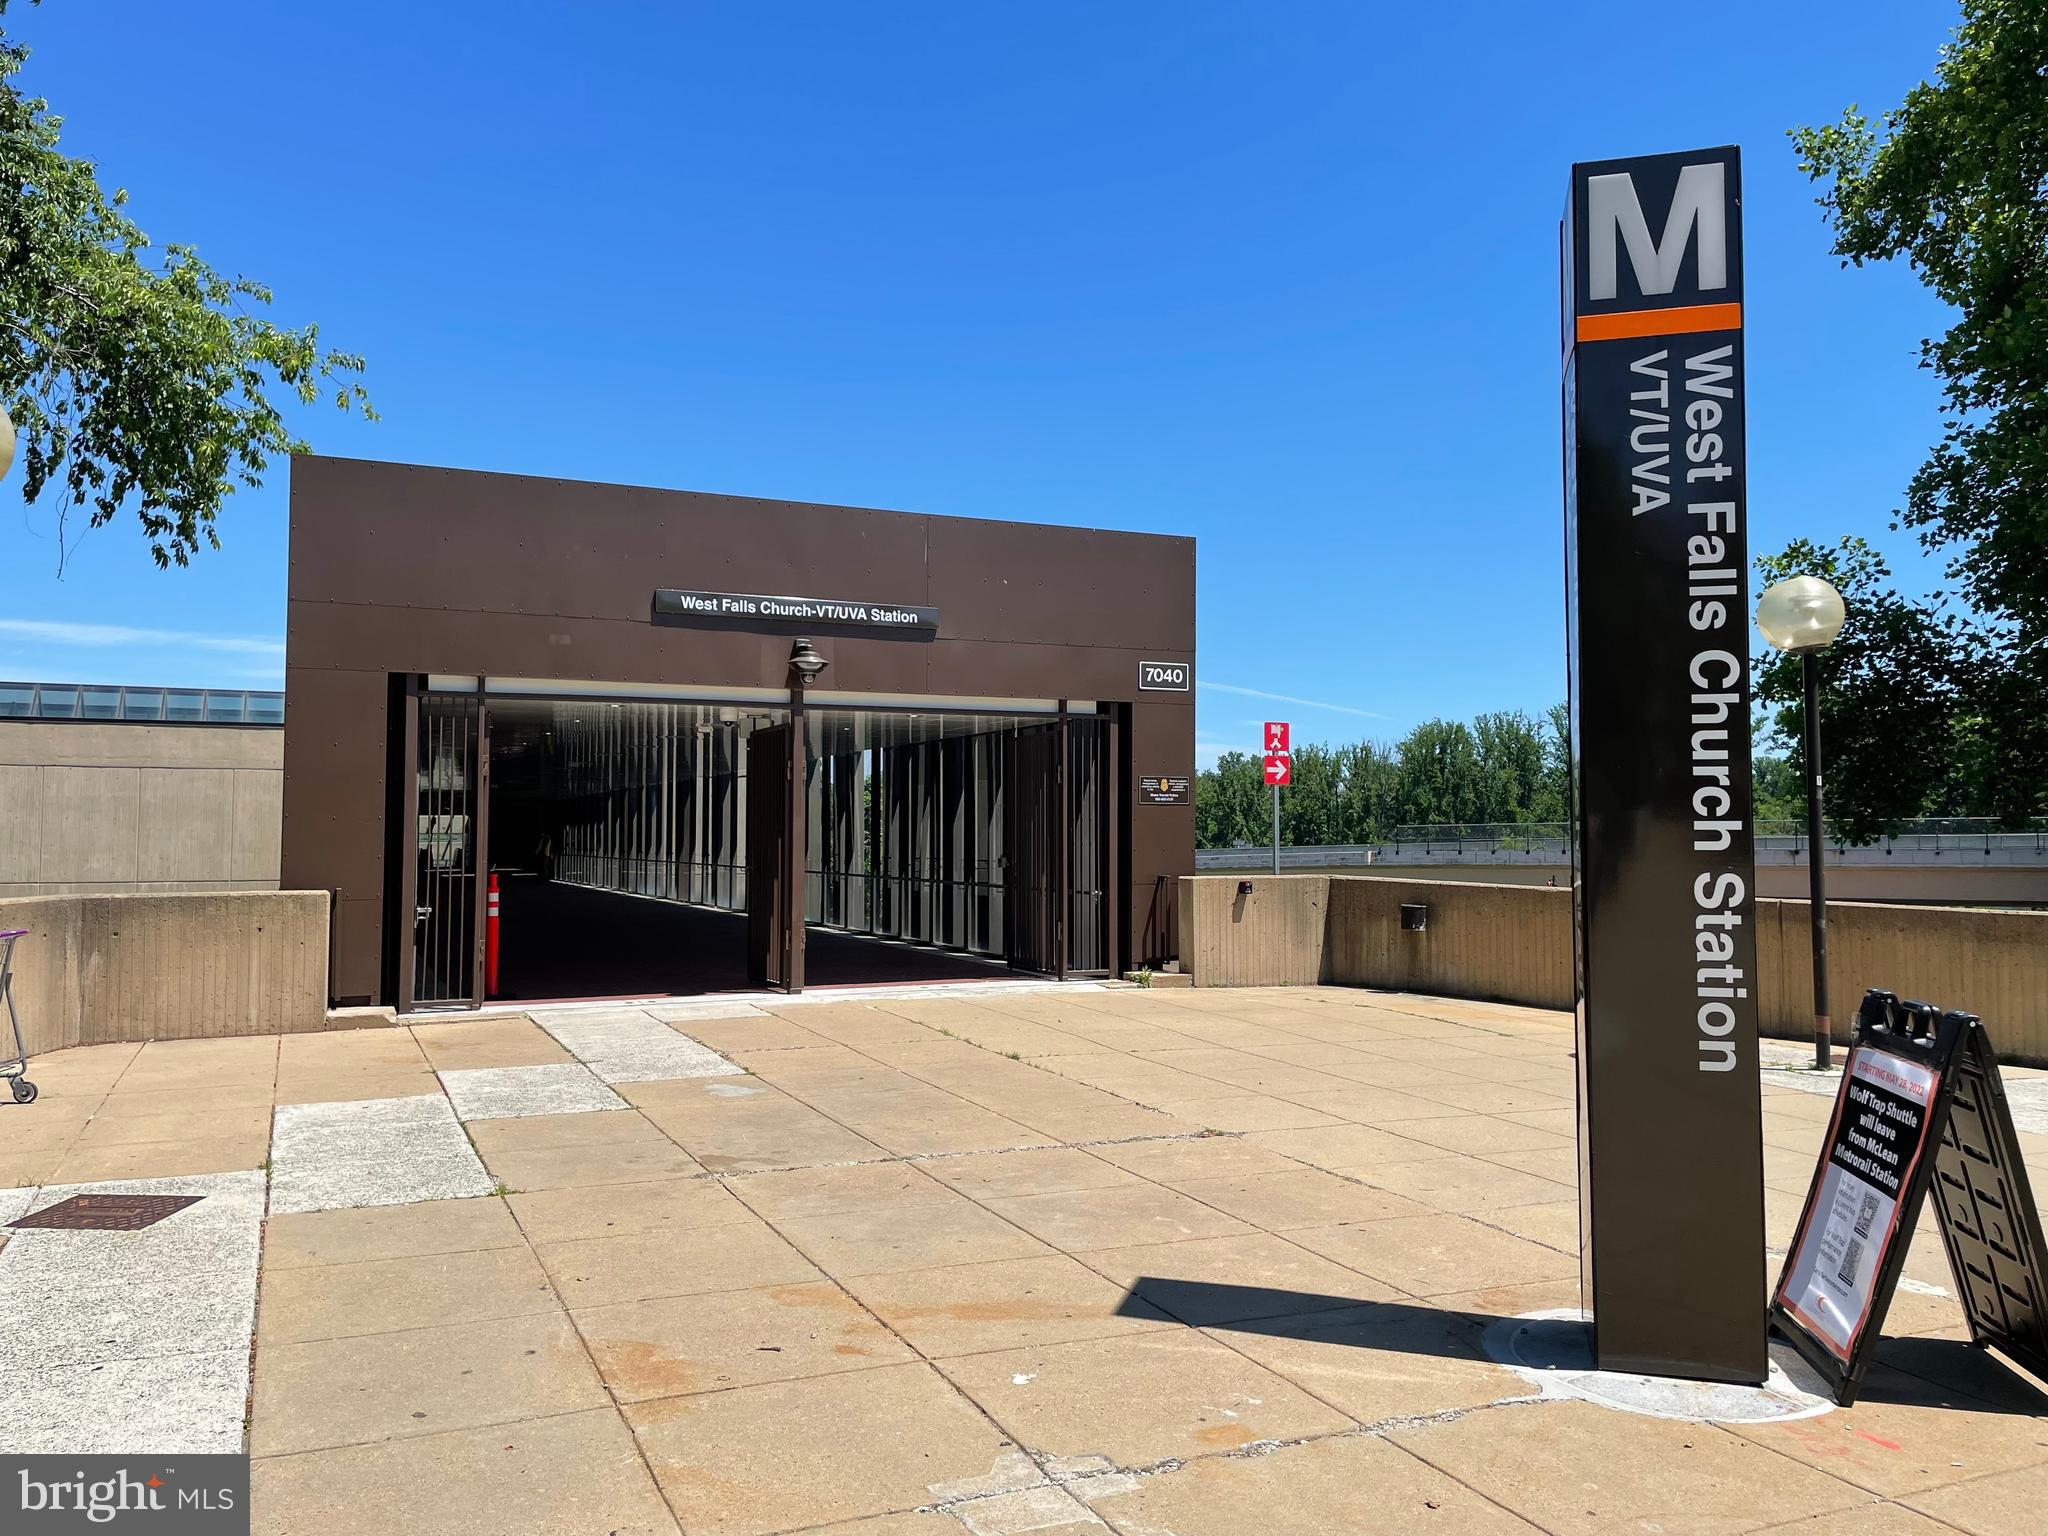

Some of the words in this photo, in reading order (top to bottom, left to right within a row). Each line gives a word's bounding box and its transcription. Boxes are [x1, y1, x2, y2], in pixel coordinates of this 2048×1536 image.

[1588, 161, 1727, 301] M
[1629, 349, 1671, 516] VT/UVA
[1684, 344, 1734, 483] West
[1687, 501, 1738, 632] Falls
[680, 595, 718, 611] West
[722, 598, 756, 614] Falls
[760, 601, 867, 621] Church-VT/UVA
[871, 608, 918, 624] Station
[1145, 667, 1183, 684] 7040
[1689, 650, 1743, 852] Church
[1693, 871, 1748, 1073] Station
[1857, 1060, 1886, 1080] STARTING
[1885, 1071, 1900, 1085] MAY
[1908, 1082, 1925, 1096] 2022
[1849, 1084, 1870, 1105] Wolf
[1868, 1093, 1886, 1115] Trap
[1886, 1101, 1918, 1128] Shuttle
[1859, 1113, 1876, 1130] will
[1873, 1117, 1896, 1141] leave
[1834, 1142, 1872, 1174] Metrorail
[1870, 1162, 1899, 1190] Station
[1848, 1126, 1867, 1149] from
[1866, 1137, 1899, 1166] McLean
